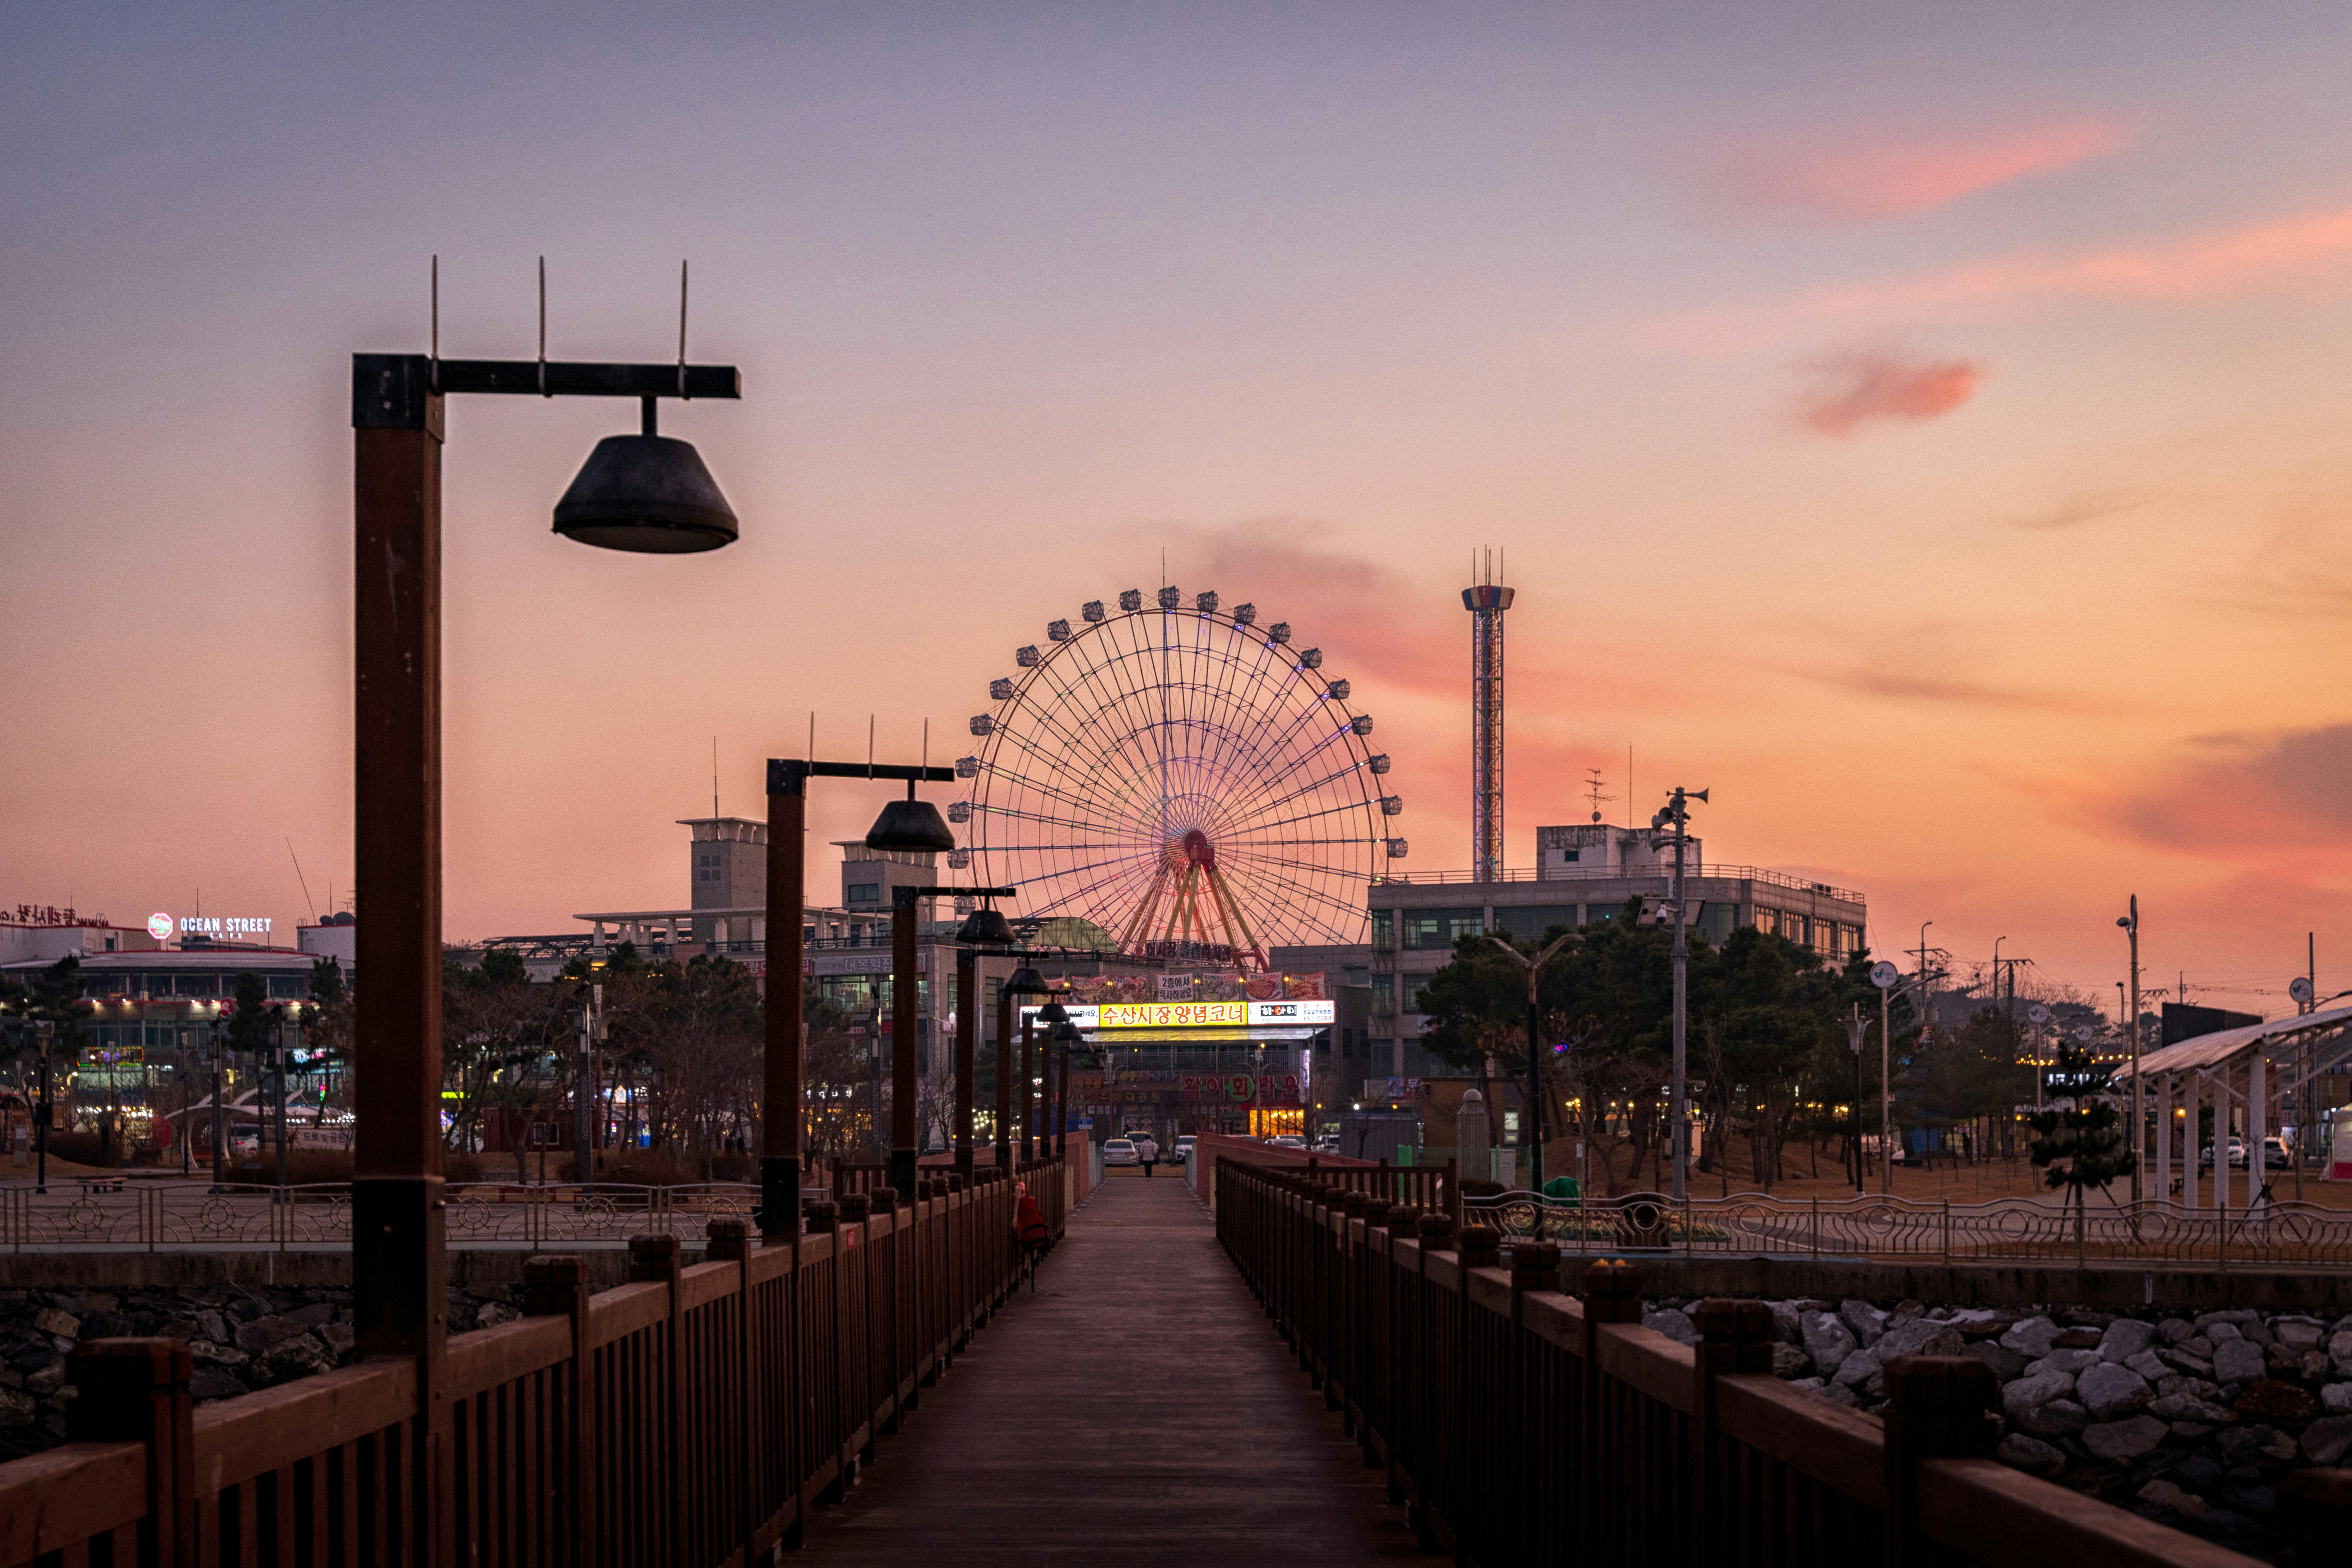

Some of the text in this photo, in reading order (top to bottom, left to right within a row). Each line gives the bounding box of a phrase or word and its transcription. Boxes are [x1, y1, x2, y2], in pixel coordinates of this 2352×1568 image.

[181, 917, 271, 932] OCEAN STREET
[1162, 976, 1189, 988] 2층에서
[1159, 988, 1192, 1000] 식사하세요
